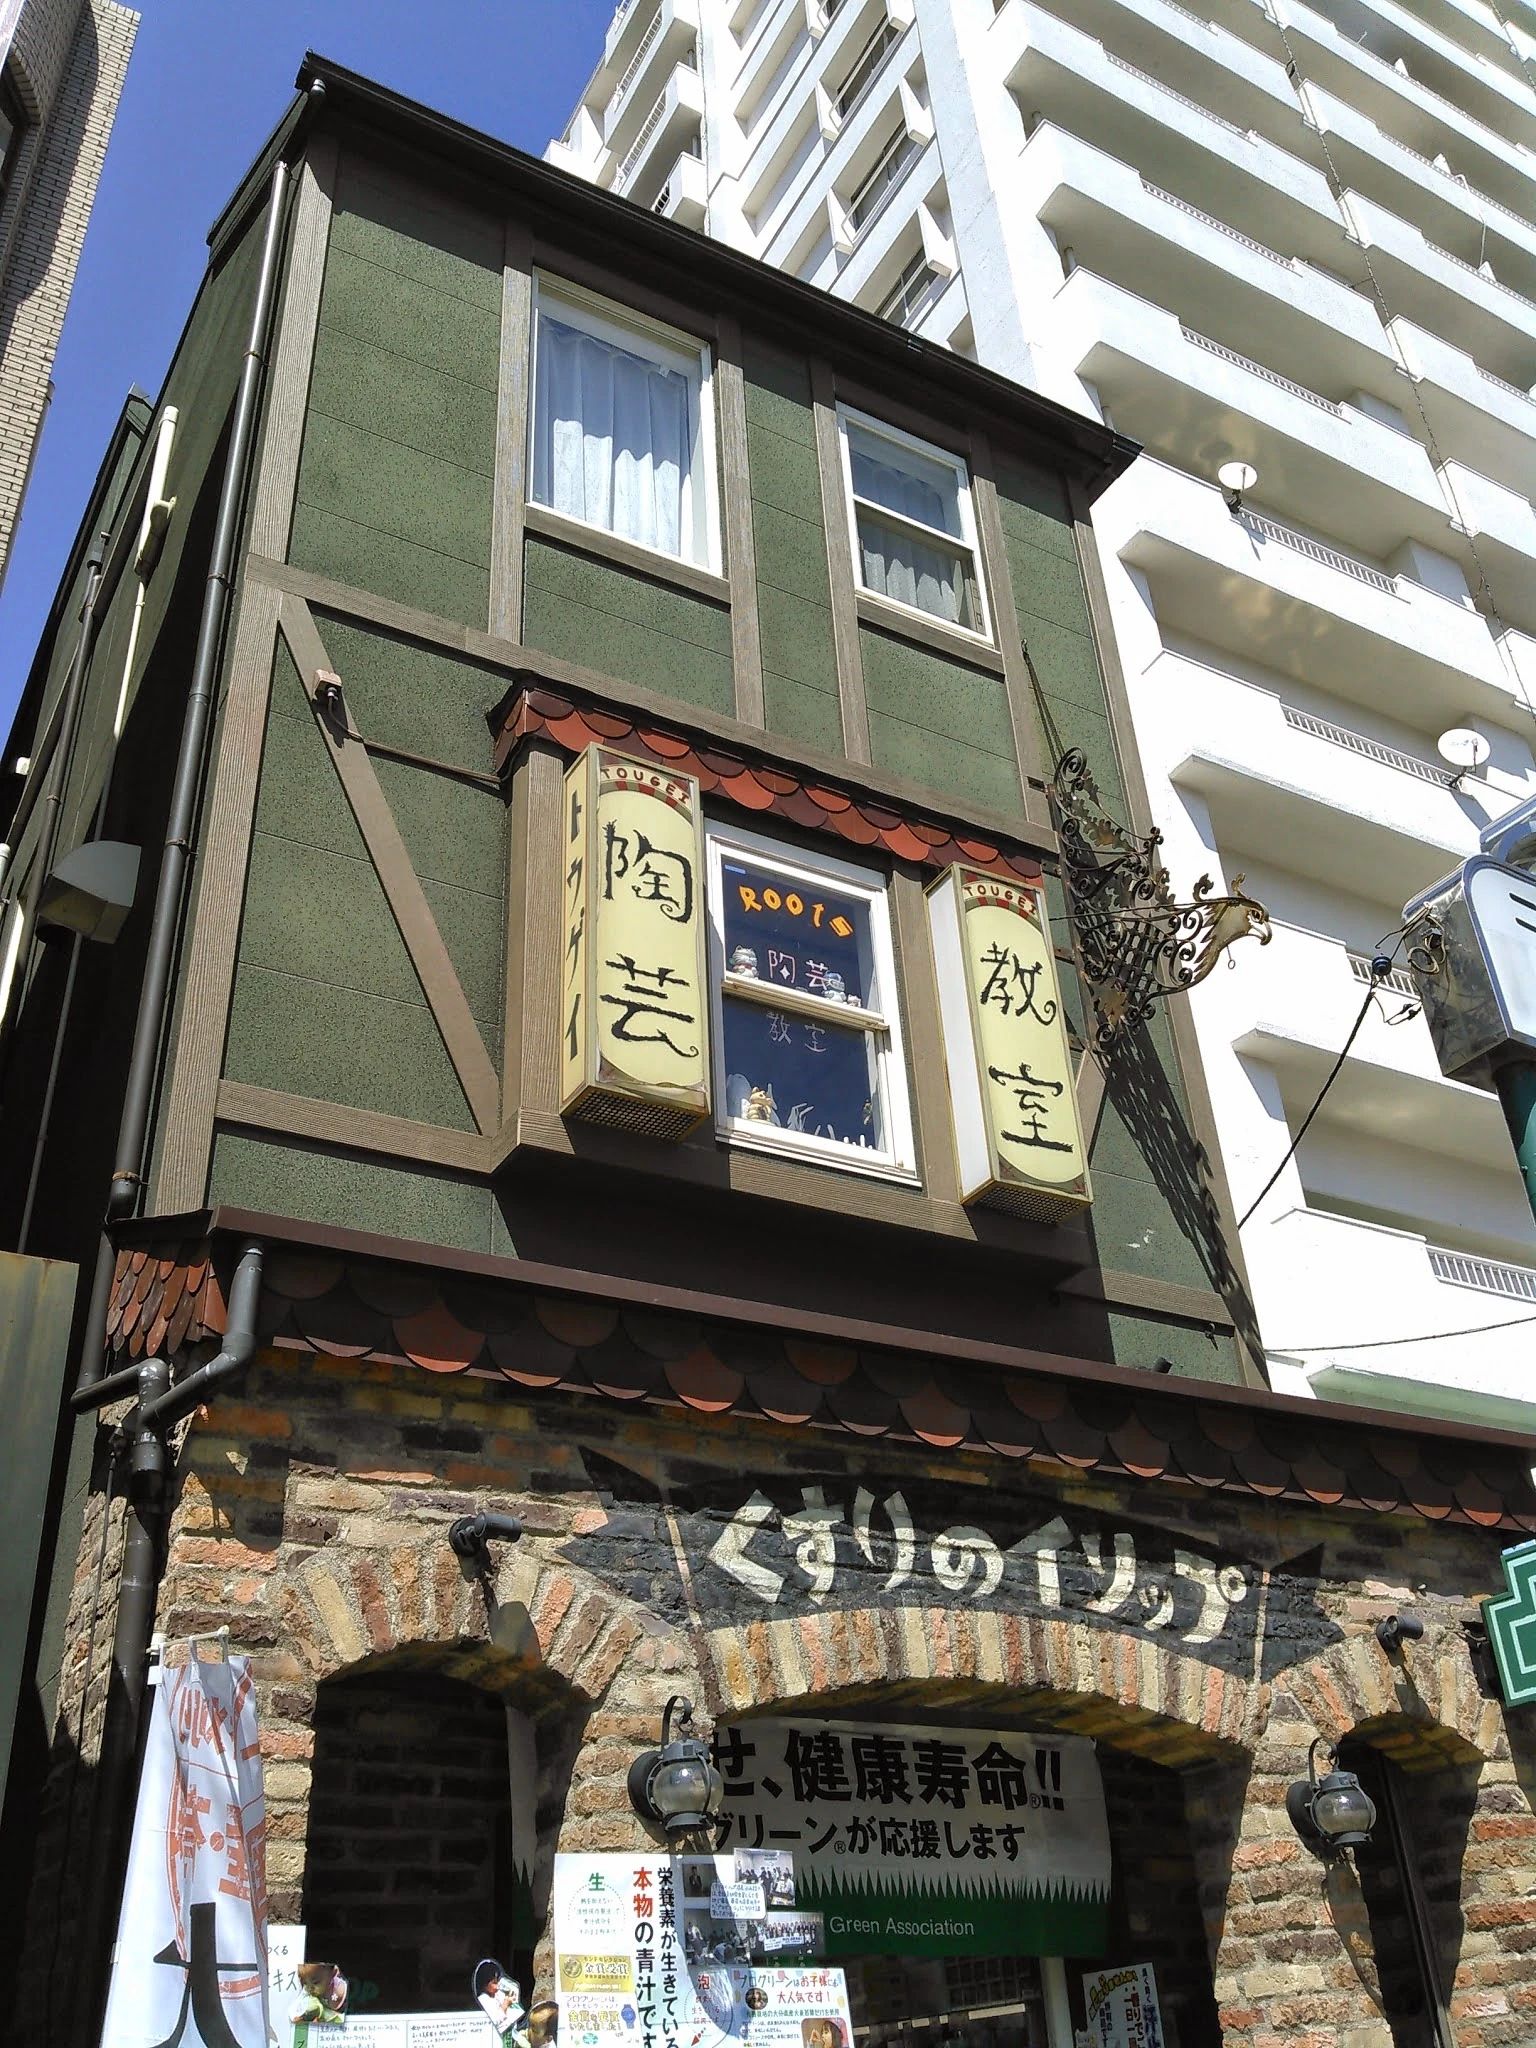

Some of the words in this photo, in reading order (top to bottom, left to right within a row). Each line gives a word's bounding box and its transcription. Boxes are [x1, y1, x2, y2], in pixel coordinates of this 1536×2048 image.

[600, 766, 690, 804] TOUGEI
[963, 885, 1037, 916] TOUGEI
[564, 789, 585, 1062] トウゲイ
[599, 818, 699, 1059] 陶芸
[980, 941, 1074, 1154] 教室
[588, 1872, 606, 1892] 生
[829, 1915, 881, 1935] Green
[885, 1916, 975, 1936] Association
